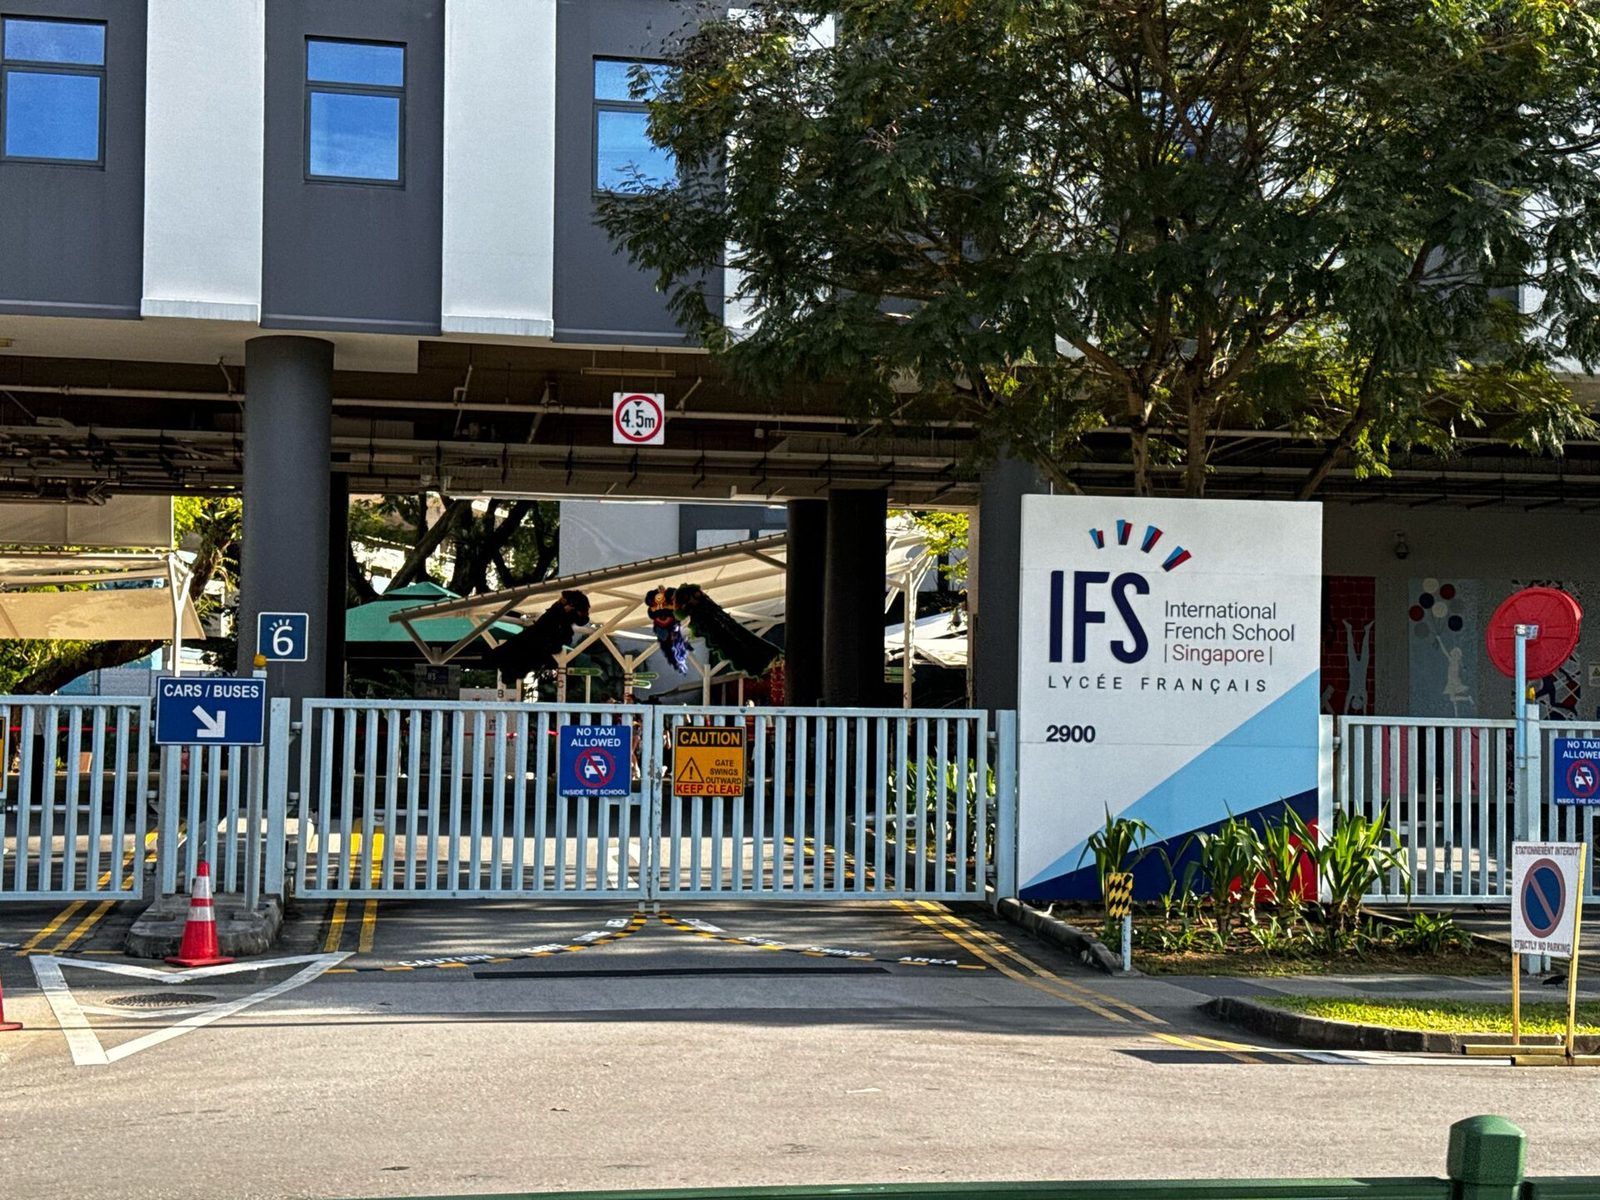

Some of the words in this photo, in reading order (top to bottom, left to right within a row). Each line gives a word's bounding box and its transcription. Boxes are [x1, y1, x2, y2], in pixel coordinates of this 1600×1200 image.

[621, 409, 655, 428] 4.5m
[1049, 570, 1150, 664] IFS
[1165, 601, 1277, 620] International
[1164, 622, 1226, 640] French
[1232, 624, 1295, 642] School
[272, 625, 294, 656] 6
[164, 684, 202, 697] CARS
[213, 685, 259, 698] BUSES
[1048, 674, 1123, 690] LYCÉE
[1141, 678, 1267, 694] FRANÇAIS
[576, 728, 592, 736] NO
[594, 728, 616, 736] TAXI
[680, 731, 740, 745] CAUTION
[1046, 725, 1096, 743] 2900
[570, 738, 621, 747] ALLOWED
[1567, 741, 1580, 749] NO
[1562, 750, 1600, 759] ALLOWE
[715, 759, 735, 767] GATE
[710, 768, 738, 776] SWINGS
[676, 784, 704, 794] KEEP
[706, 784, 741, 794] CLEAR
